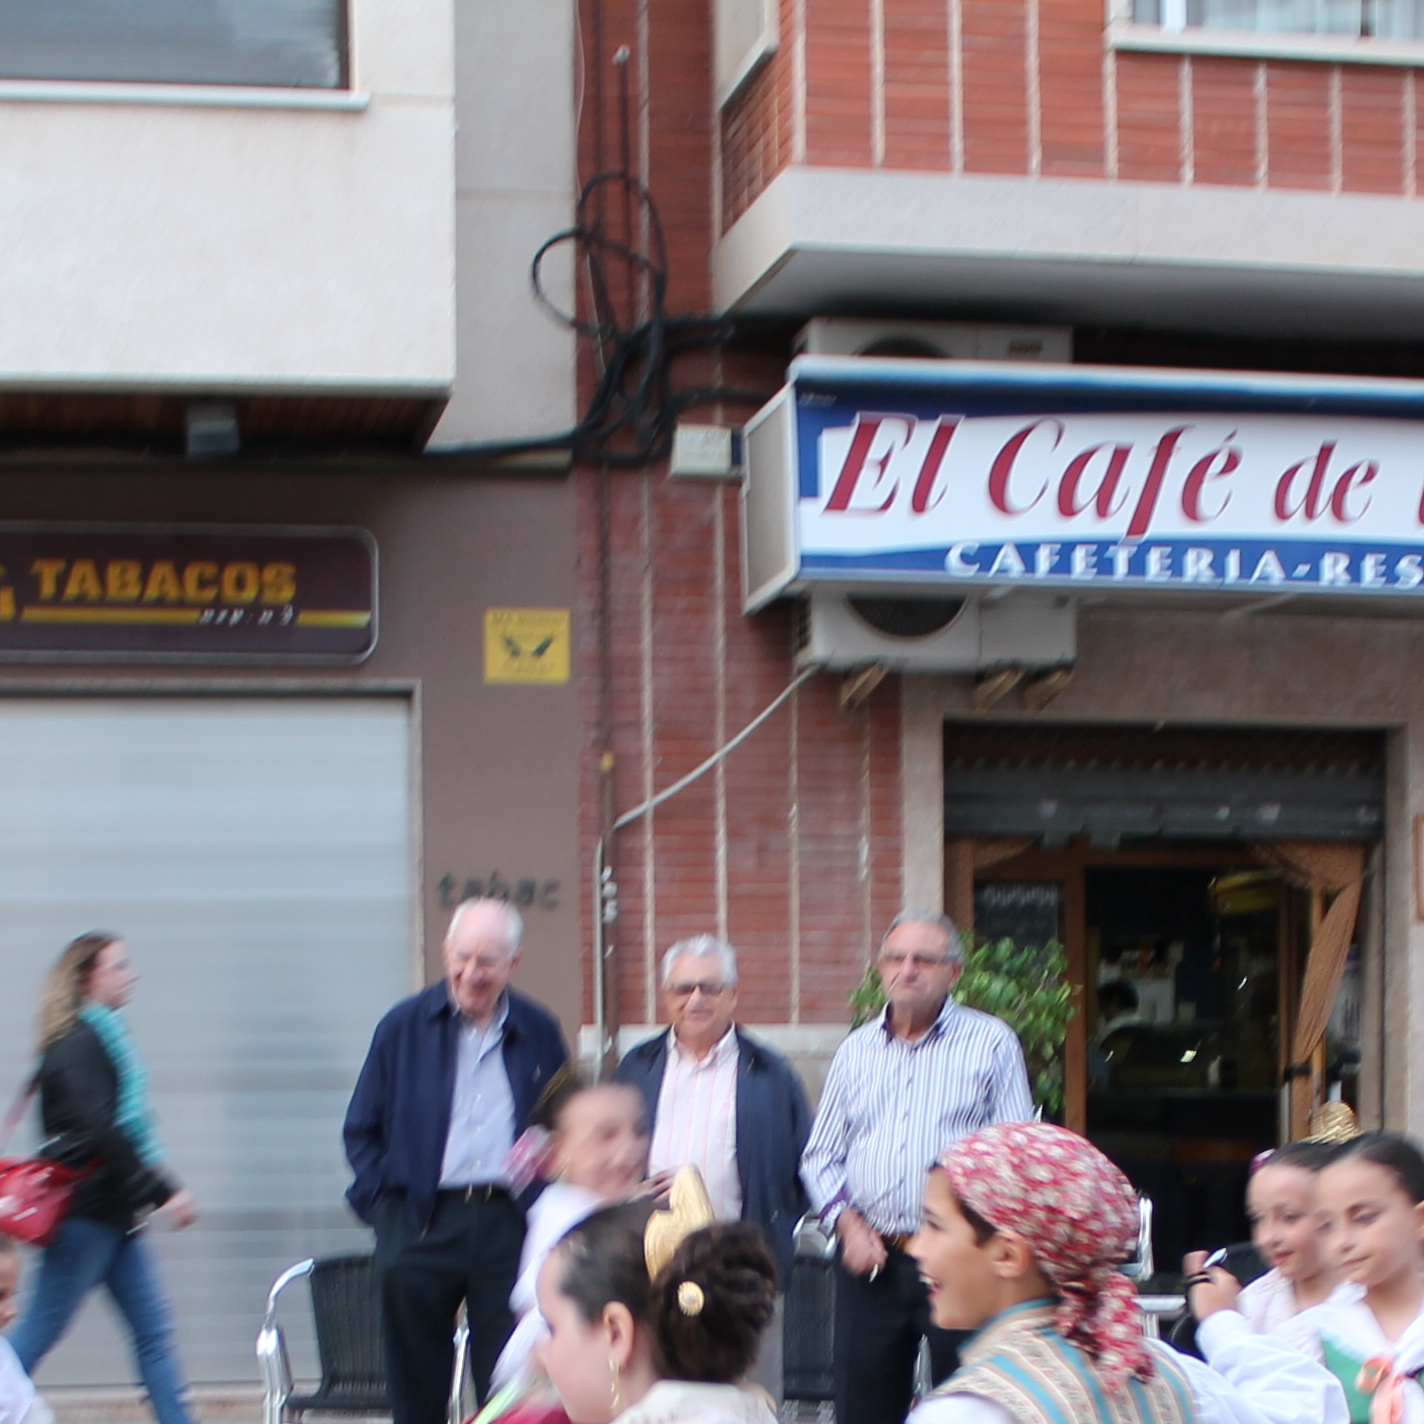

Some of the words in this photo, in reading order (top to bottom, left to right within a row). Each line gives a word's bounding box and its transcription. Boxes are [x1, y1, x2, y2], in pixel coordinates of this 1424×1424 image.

[821, 411, 966, 517] El
[986, 415, 1244, 545] Café
[1273, 439, 1380, 525] de
[30, 557, 298, 607] TABACOS
